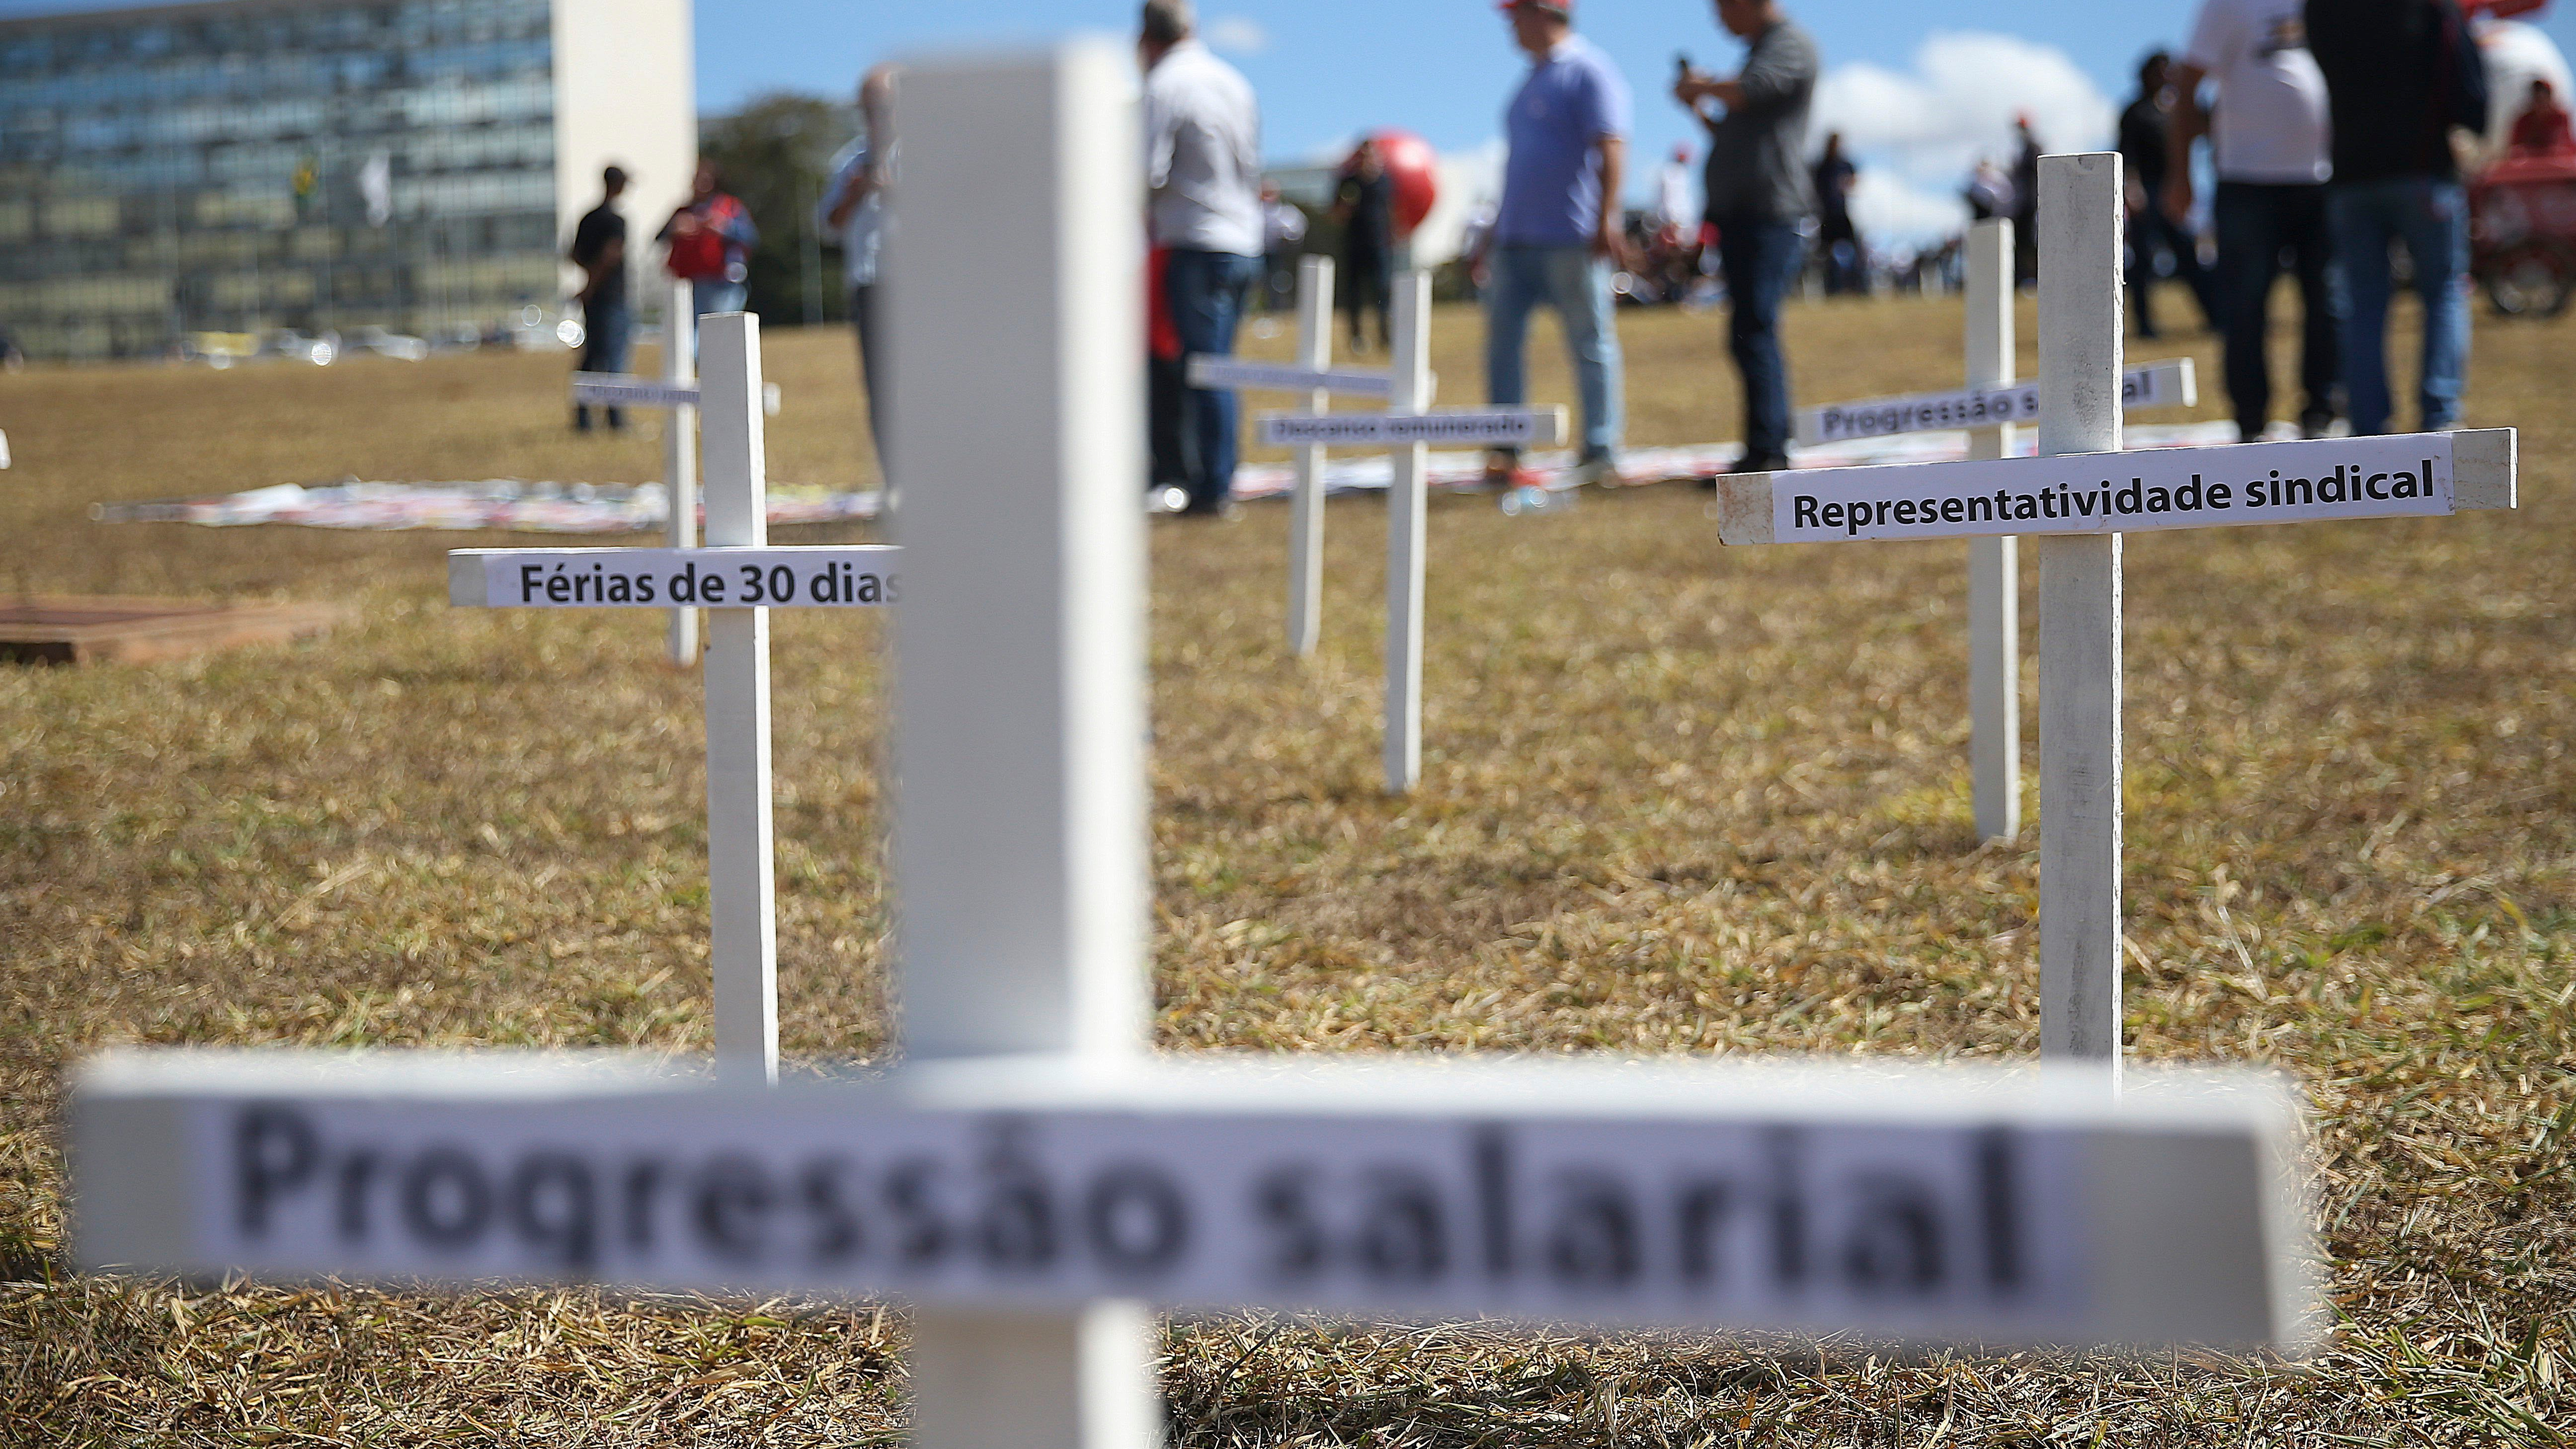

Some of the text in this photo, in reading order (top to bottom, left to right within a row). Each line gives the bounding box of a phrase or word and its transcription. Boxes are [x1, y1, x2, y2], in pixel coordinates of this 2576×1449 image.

[1823, 390, 2011, 434] Progressão
[1794, 459, 2434, 535] Representatividade sindical
[520, 562, 903, 603] Férias de 30 dias
[229, 1102, 2033, 1296] Progressão salarial
